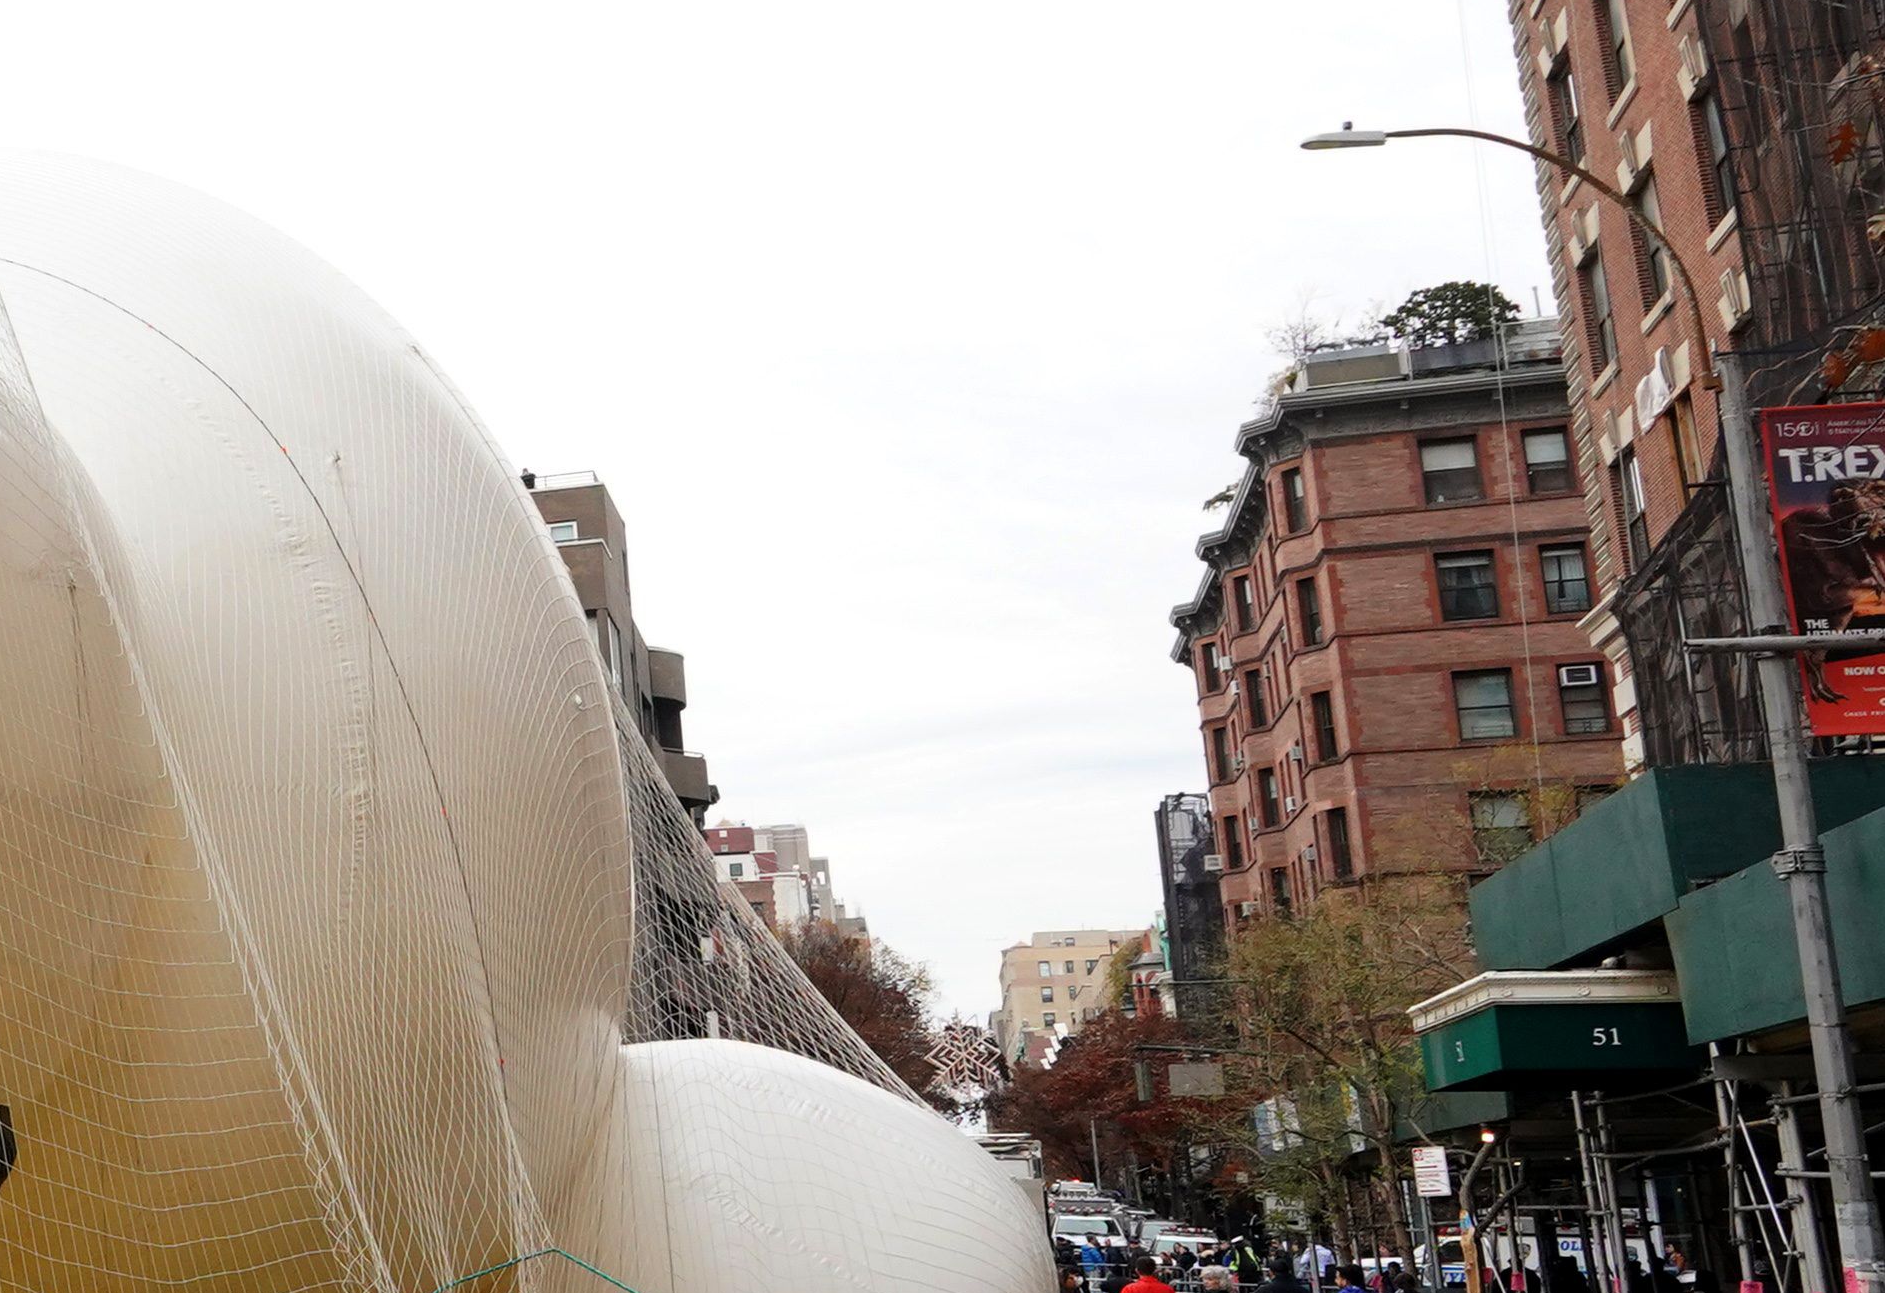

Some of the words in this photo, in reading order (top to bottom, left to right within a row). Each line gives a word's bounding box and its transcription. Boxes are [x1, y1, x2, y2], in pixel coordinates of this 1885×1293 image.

[1804, 619, 1830, 629] THE
[1844, 666, 1876, 676] NOW
[1592, 1027, 1622, 1046] 51
